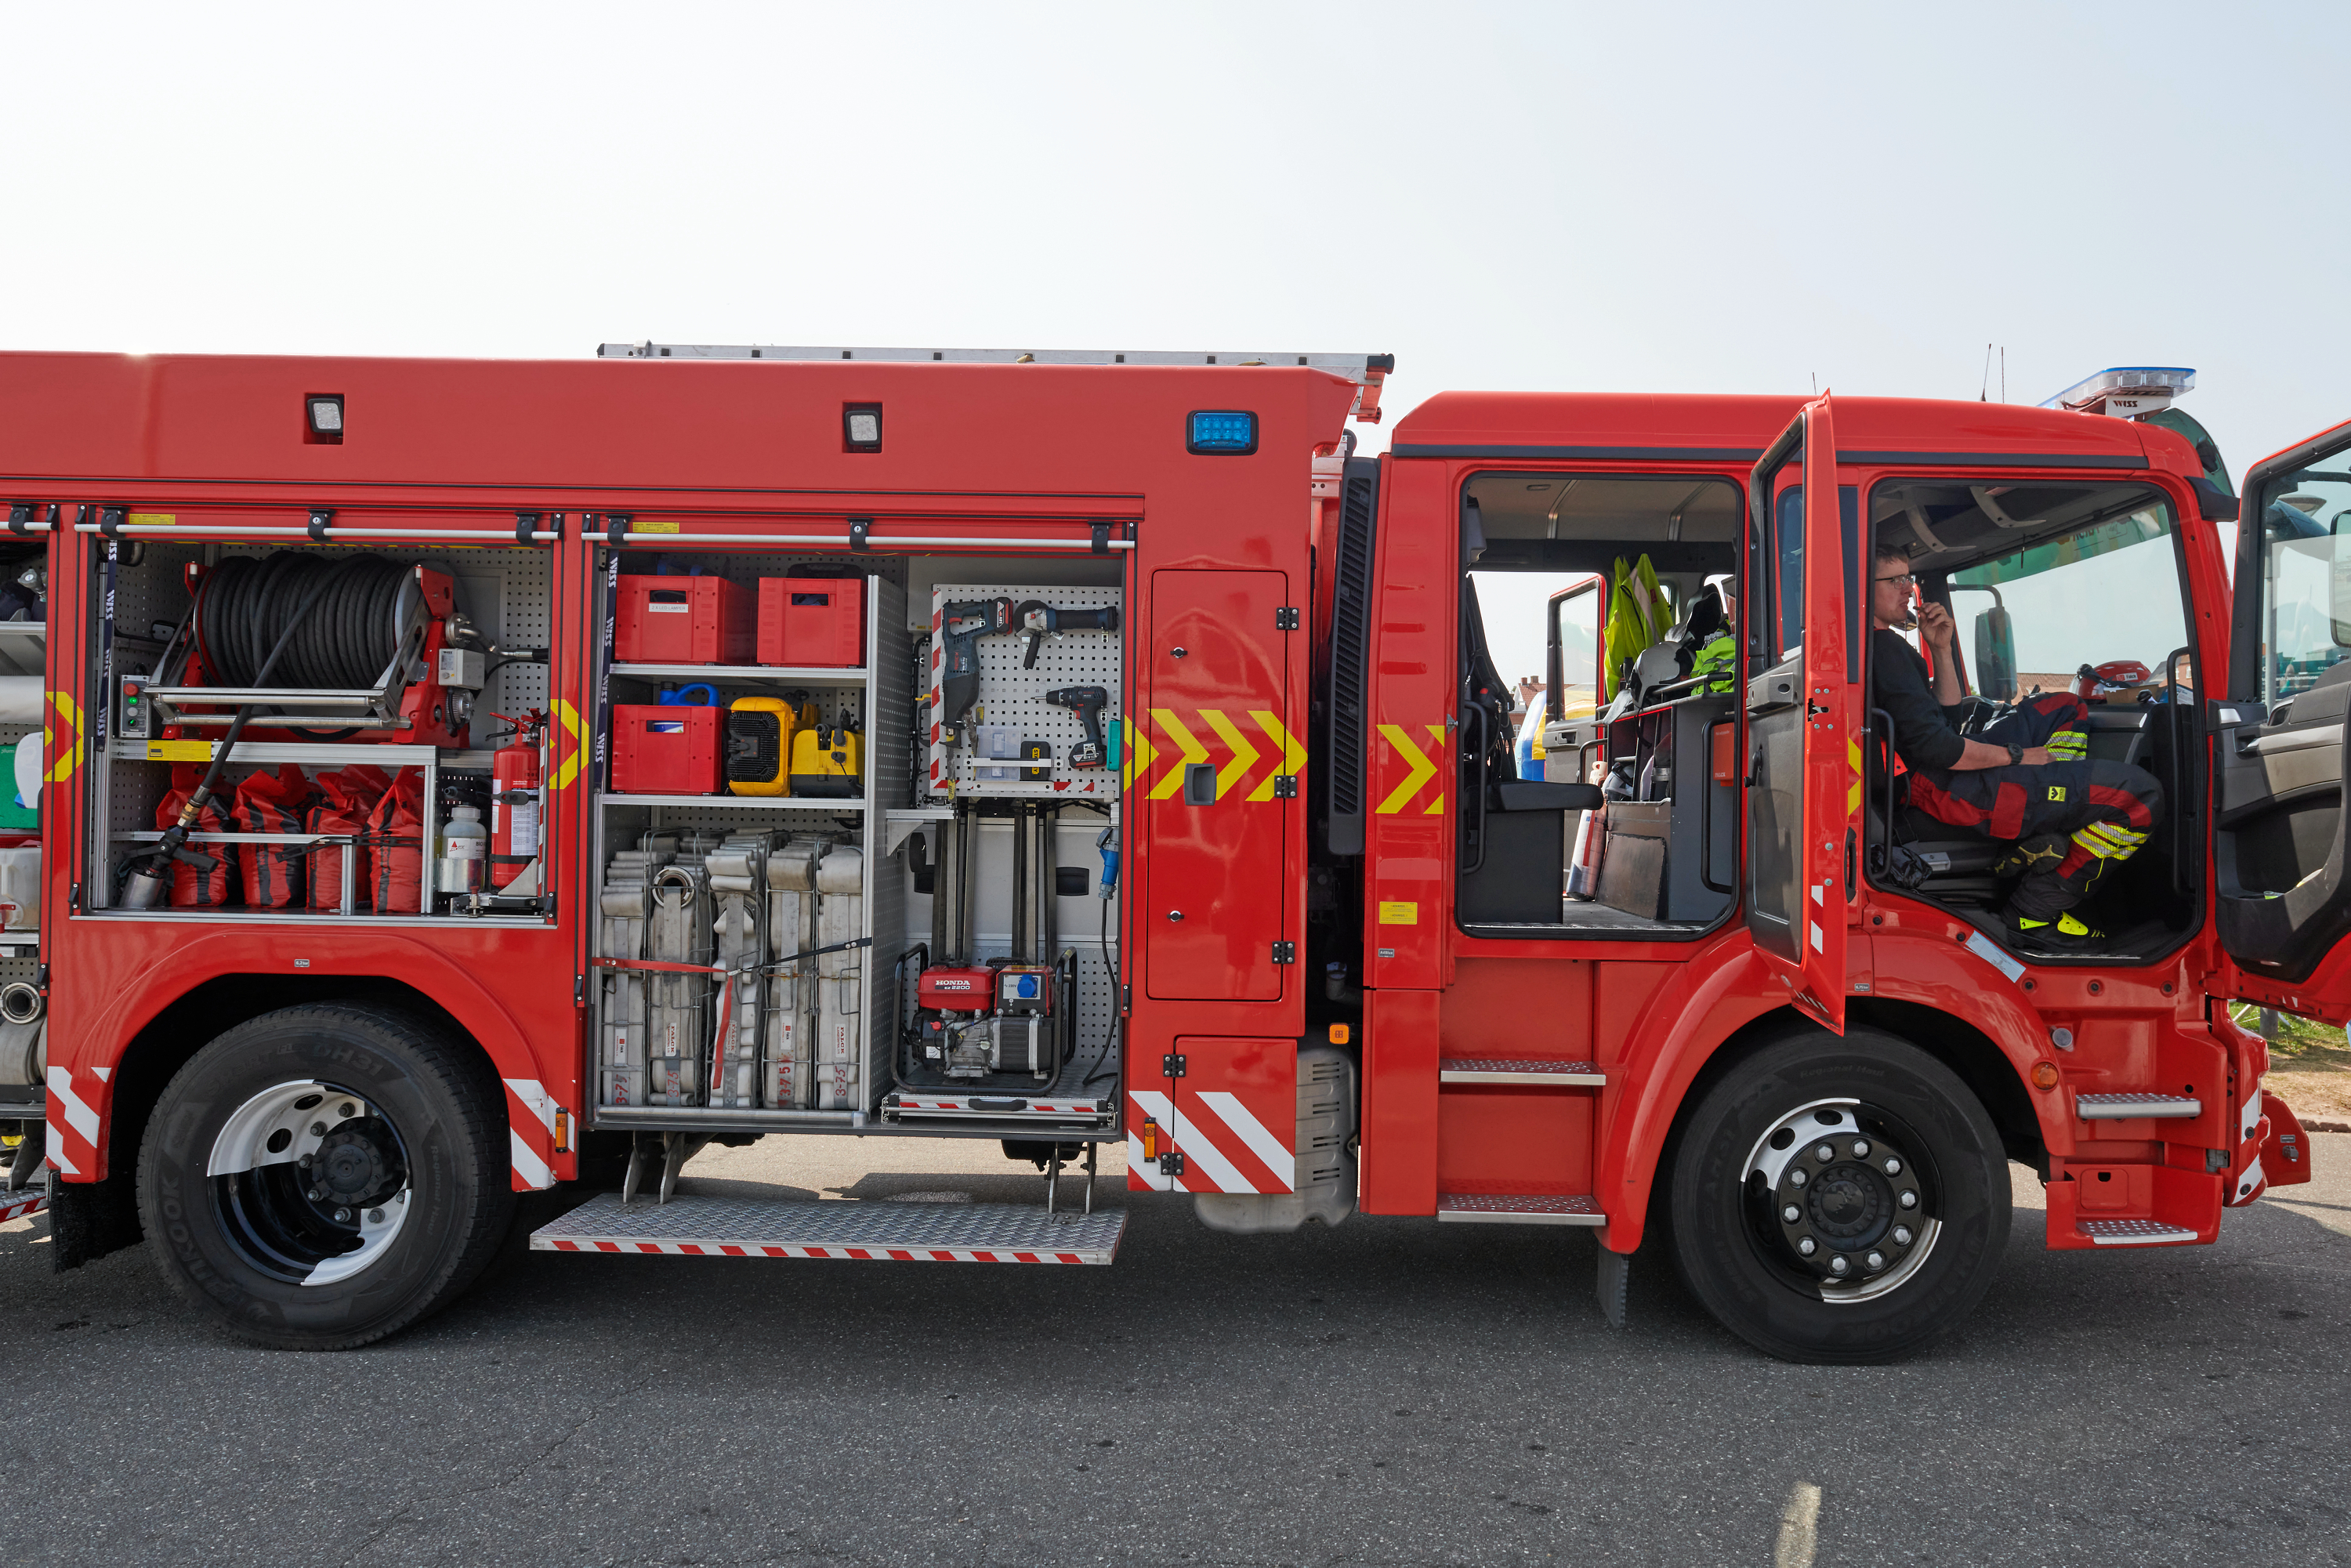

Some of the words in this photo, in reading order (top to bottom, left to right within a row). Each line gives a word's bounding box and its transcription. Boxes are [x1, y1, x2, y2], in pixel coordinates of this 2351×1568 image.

[108, 540, 118, 560] ISS
[608, 556, 618, 588] WISS
[105, 589, 115, 621] WISS
[604, 616, 614, 647] WISS
[97, 706, 107, 737] WISS
[595, 732, 606, 763] WISS
[312, 1042, 384, 1077] DH31
[1800, 1065, 1853, 1078] Regional
[1857, 1066, 1886, 1077] Haul
[667, 1070, 679, 1098] 3-75
[779, 1066, 792, 1096] 3-75
[835, 1066, 846, 1096] 3-75
[430, 1145, 443, 1202] Regional
[426, 1204, 441, 1236] Haul
